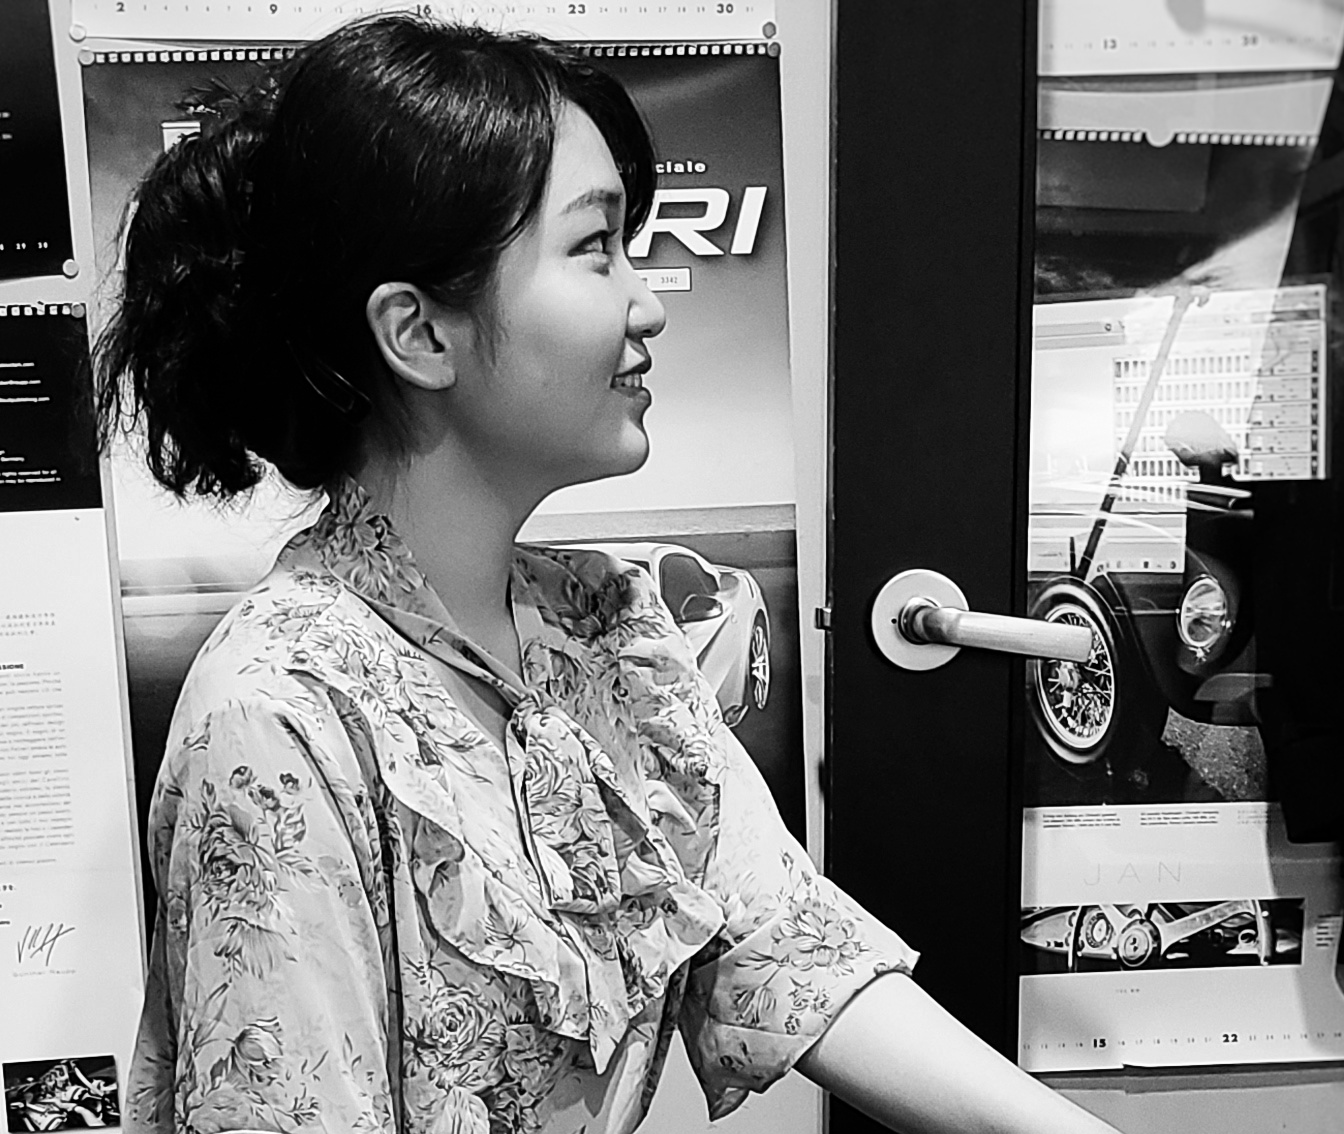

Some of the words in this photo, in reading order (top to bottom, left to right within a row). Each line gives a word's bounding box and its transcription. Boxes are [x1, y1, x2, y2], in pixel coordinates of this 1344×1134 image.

[115, 1, 126, 13] 2
[268, 3, 279, 15] 9
[567, 3, 587, 15] 23
[715, 3, 735, 15] 30
[627, 186, 768, 257] RI
[1083, 860, 1182, 887] JAN
[1092, 1038, 1107, 1049] 15
[1222, 1033, 1239, 1044] 22
